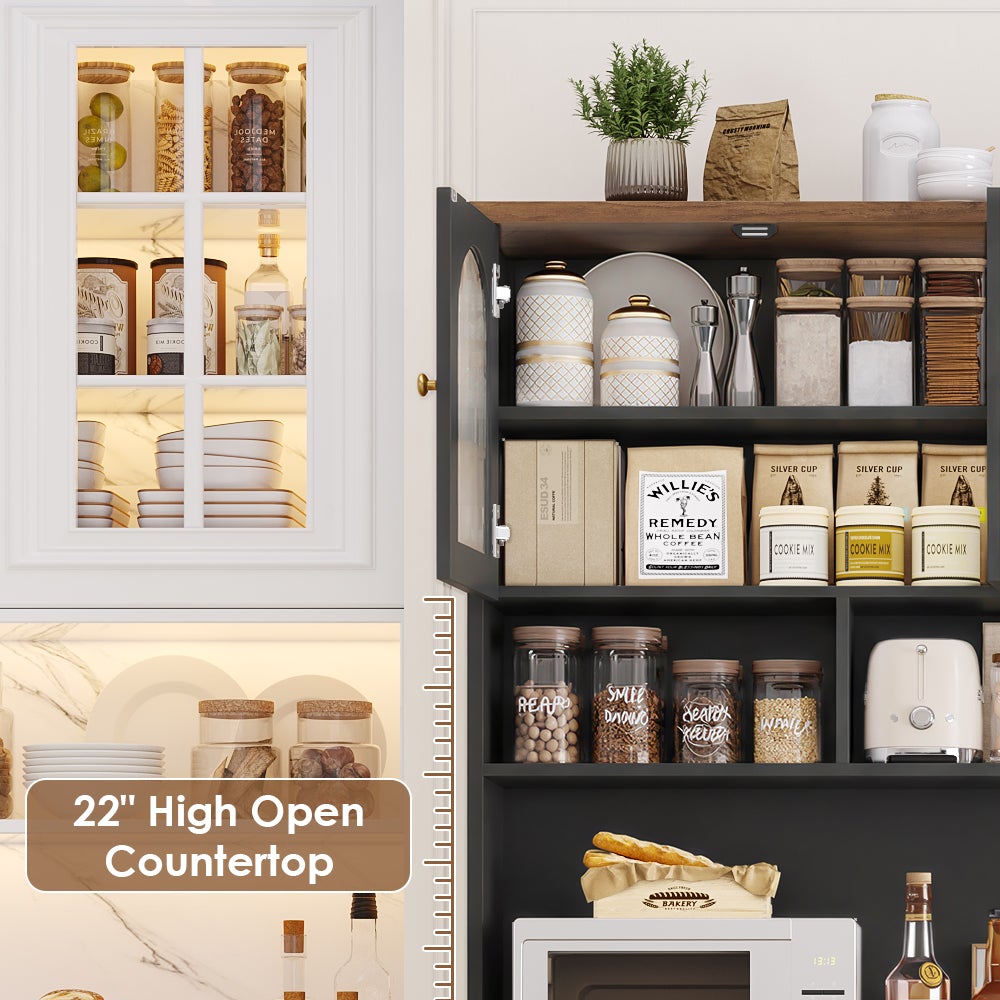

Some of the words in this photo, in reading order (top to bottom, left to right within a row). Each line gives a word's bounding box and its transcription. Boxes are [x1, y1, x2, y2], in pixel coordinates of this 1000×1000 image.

[770, 465, 798, 473] SILVER
[801, 465, 818, 473] CUP
[856, 465, 884, 473] SILVER
[886, 465, 903, 473] CUP
[940, 465, 968, 473] SILVER
[970, 465, 987, 473] CUP
[647, 480, 720, 502] WILLIE'S
[649, 518, 718, 528] REMEDY
[645, 532, 686, 541] WHOLE
[689, 532, 721, 541] BEAN
[774, 544, 801, 555] COOKIE
[802, 544, 815, 555] MIX
[850, 543, 877, 555] COOKIE
[878, 543, 891, 555] MIX
[926, 543, 953, 555] COOKIE
[954, 543, 967, 555] MIX
